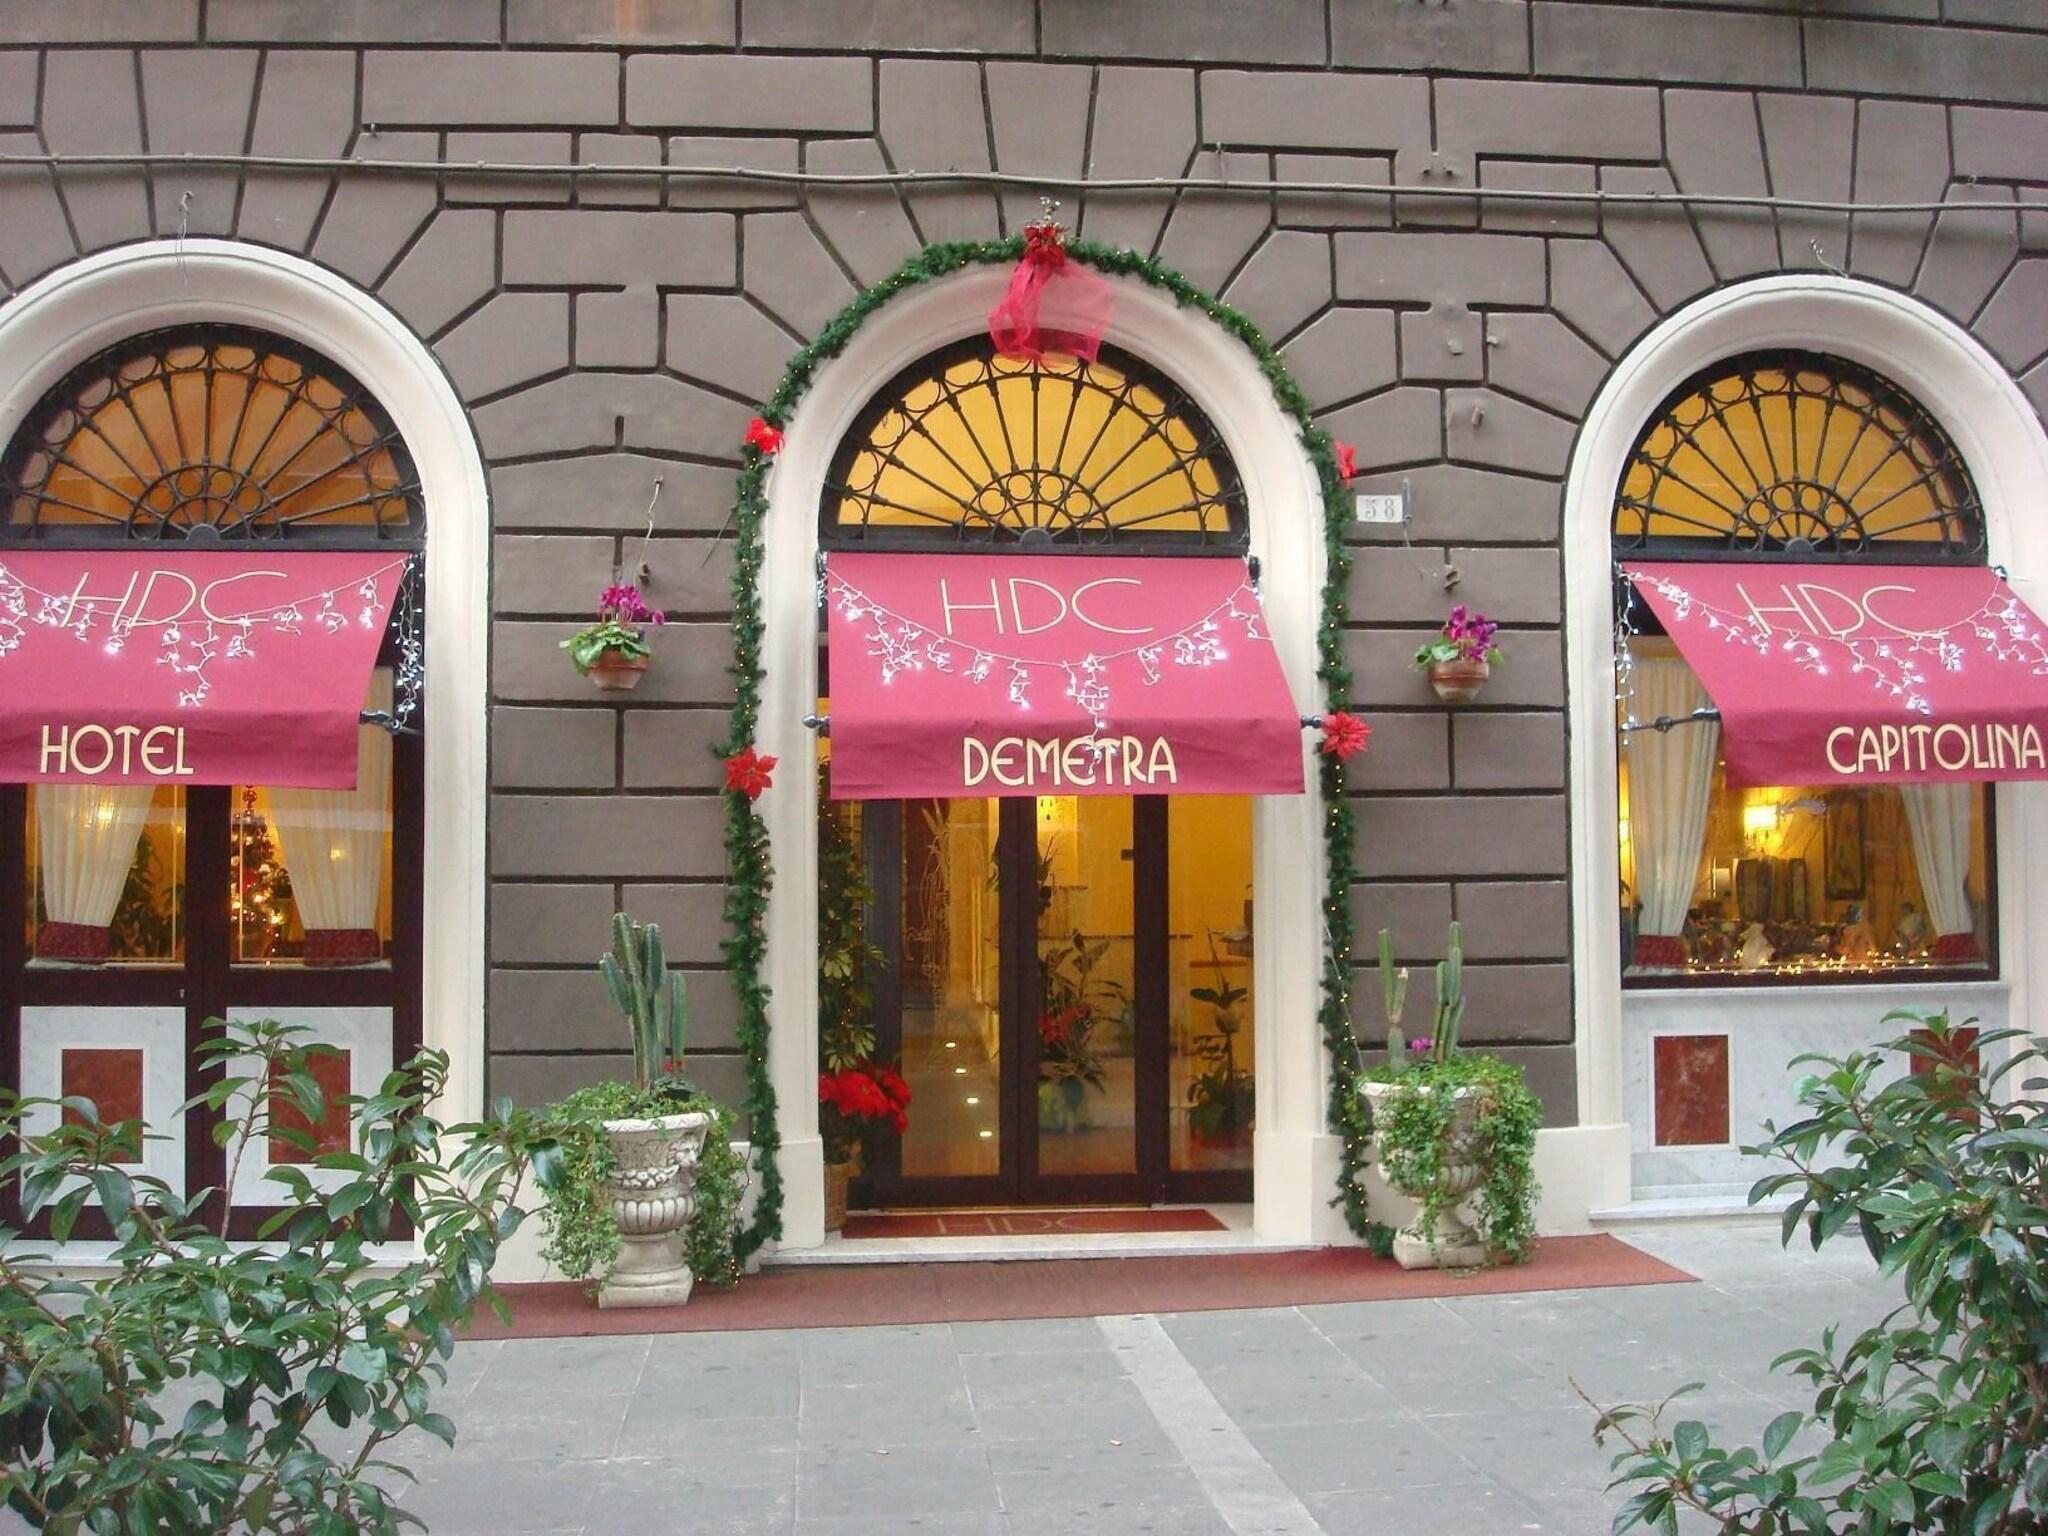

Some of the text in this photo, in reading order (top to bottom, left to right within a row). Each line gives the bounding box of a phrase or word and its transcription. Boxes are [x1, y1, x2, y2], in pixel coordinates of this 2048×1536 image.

[60, 571, 288, 628] HDC
[940, 578, 1154, 635] HDC
[1736, 583, 1950, 637] HDC
[39, 724, 195, 775] HOTEL
[962, 736, 1178, 787] DEMETRA
[1826, 723, 2046, 774] CAPITOLINA
